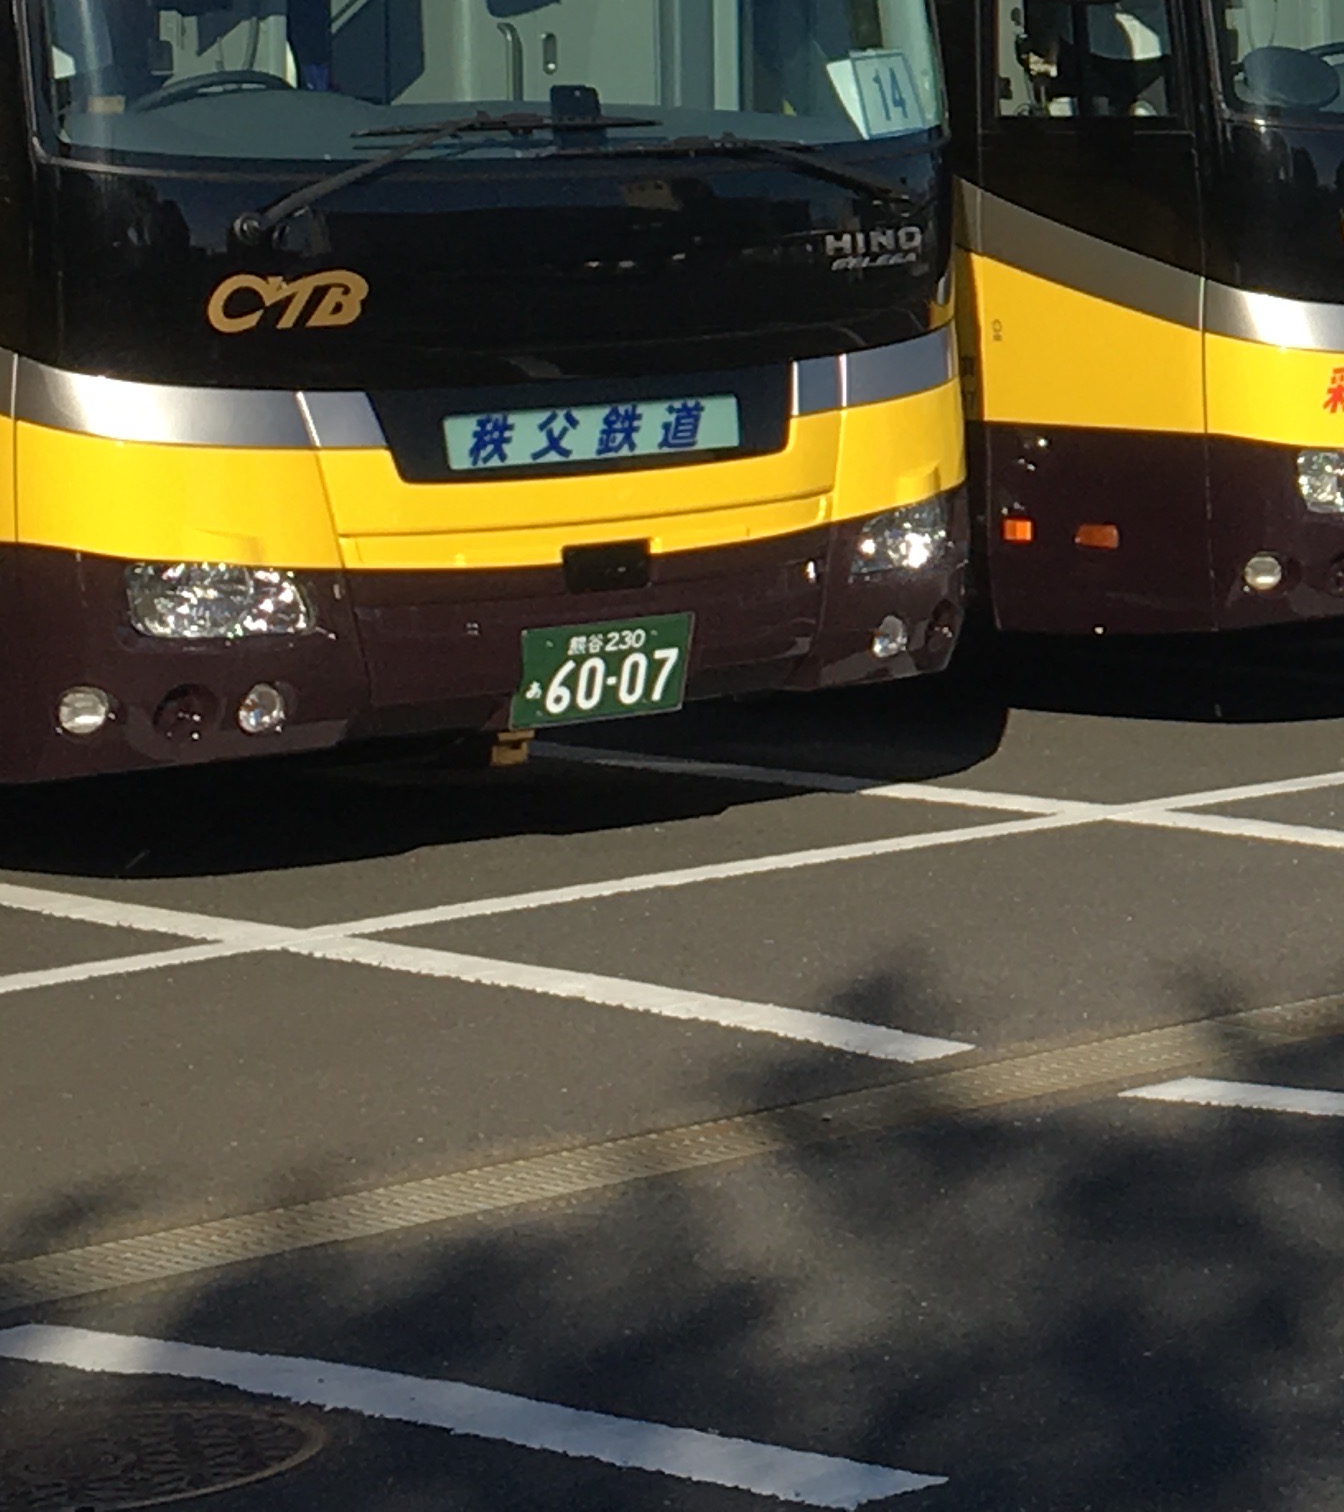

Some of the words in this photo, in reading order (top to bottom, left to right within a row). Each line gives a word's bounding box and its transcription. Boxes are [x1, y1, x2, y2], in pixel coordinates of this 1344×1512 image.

[872, 67, 909, 121] 14
[825, 226, 922, 256] HINO
[208, 270, 369, 334] CTB
[469, 399, 704, 466] 秩父鉄道
[545, 647, 679, 714] 60-07
